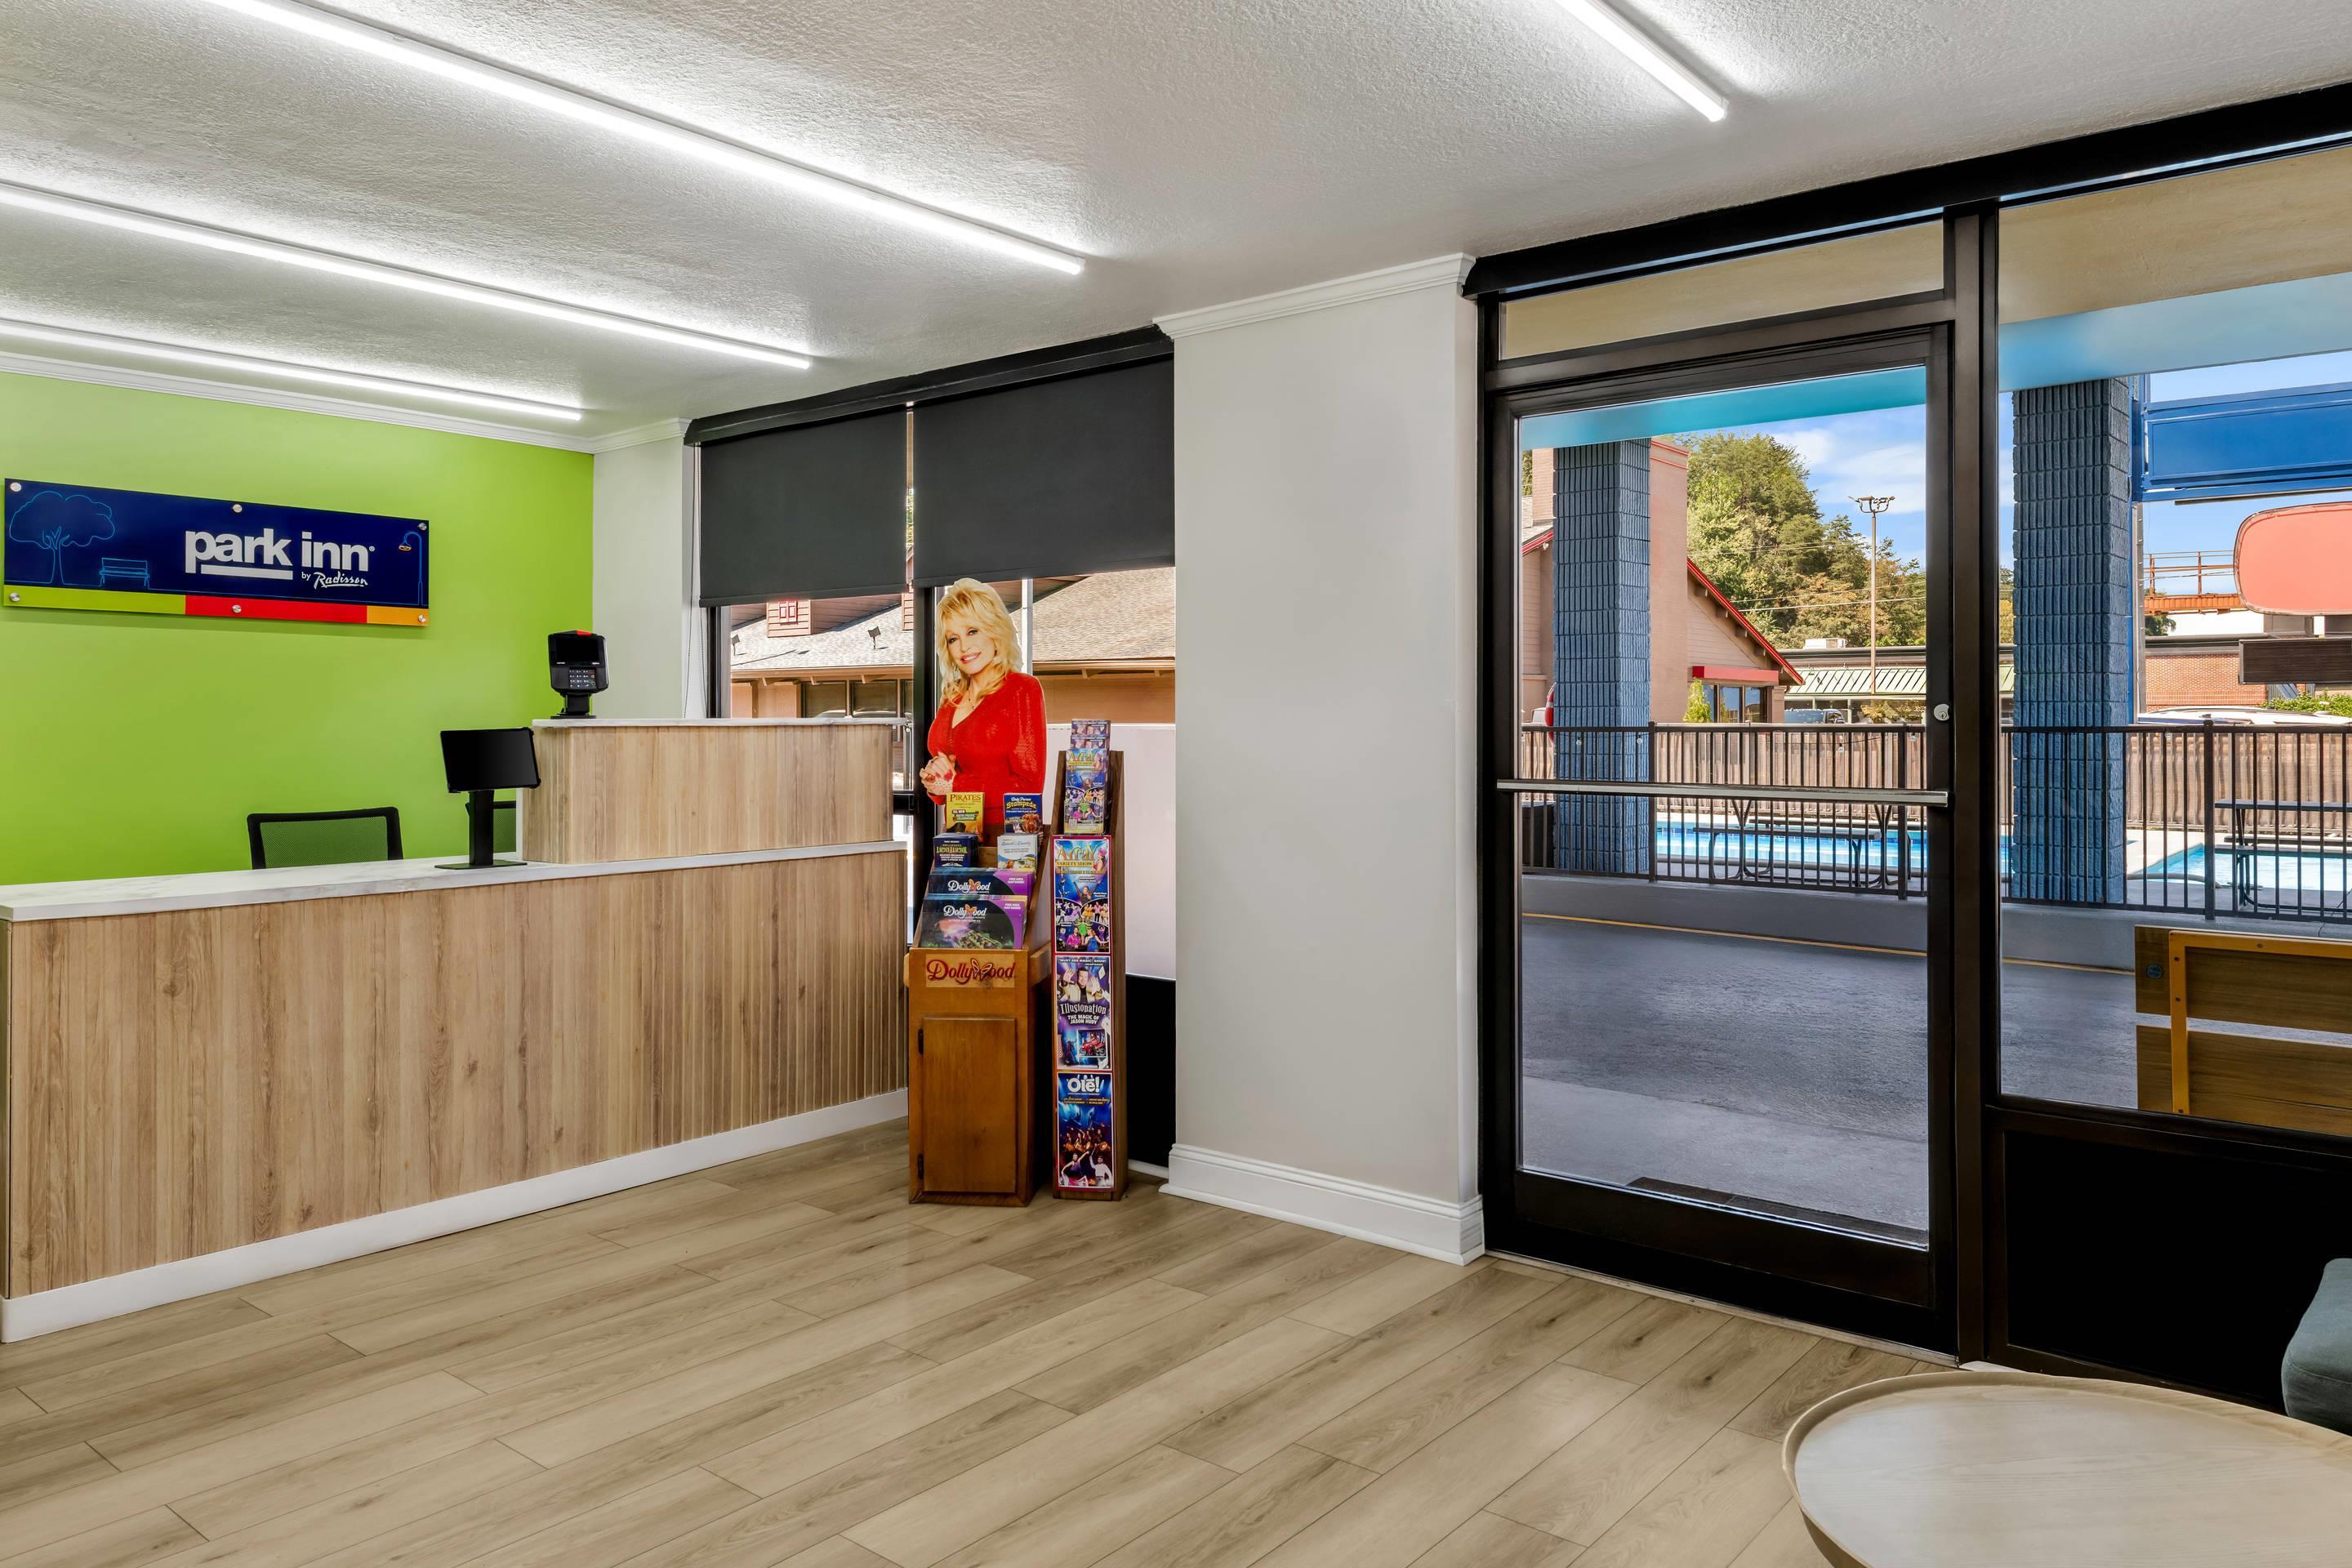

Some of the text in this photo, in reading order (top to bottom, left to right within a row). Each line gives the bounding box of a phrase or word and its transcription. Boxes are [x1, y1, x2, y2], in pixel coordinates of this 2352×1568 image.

[185, 528, 293, 573] park
[301, 571, 368, 590] by Radisson
[950, 794, 982, 803] PIRATES
[1006, 801, 1037, 809] Stampede
[926, 957, 1016, 985] Dollywood
[1060, 1003, 1107, 1014] Illusionation
